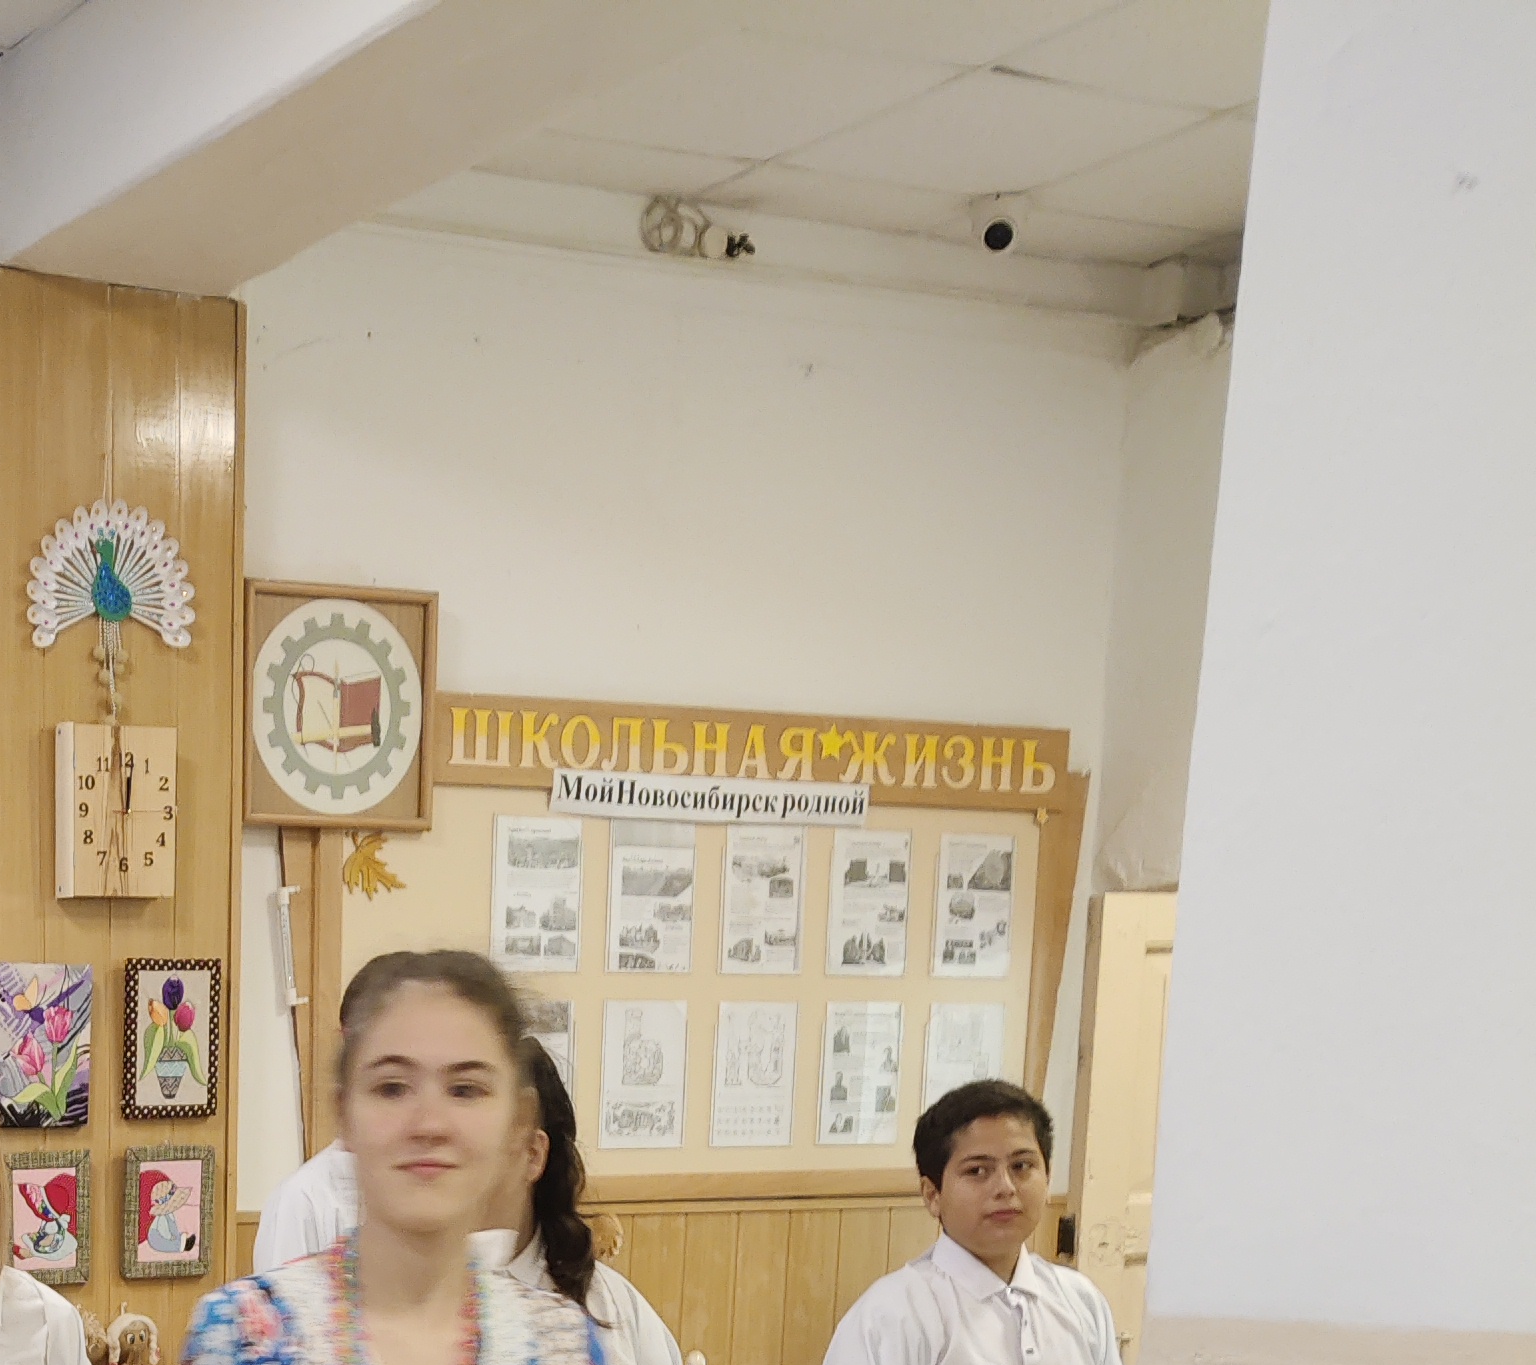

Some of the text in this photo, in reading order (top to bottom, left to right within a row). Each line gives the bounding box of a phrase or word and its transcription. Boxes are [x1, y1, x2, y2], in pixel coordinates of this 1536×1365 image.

[448, 706, 1057, 794] ШКОЛЬНАЯ ЖИЗНЬ
[97, 756, 110, 772] 11
[144, 758, 150, 774] 1
[79, 775, 95, 790] 10
[159, 776, 169, 791] 2
[79, 802, 89, 818] 9
[781, 790, 865, 818] родной
[163, 805, 173, 820] 3
[83, 829, 93, 844] 8
[156, 832, 166, 847] 4
[97, 851, 107, 866] 7
[119, 857, 129, 872] 6
[144, 852, 154, 866] 5
